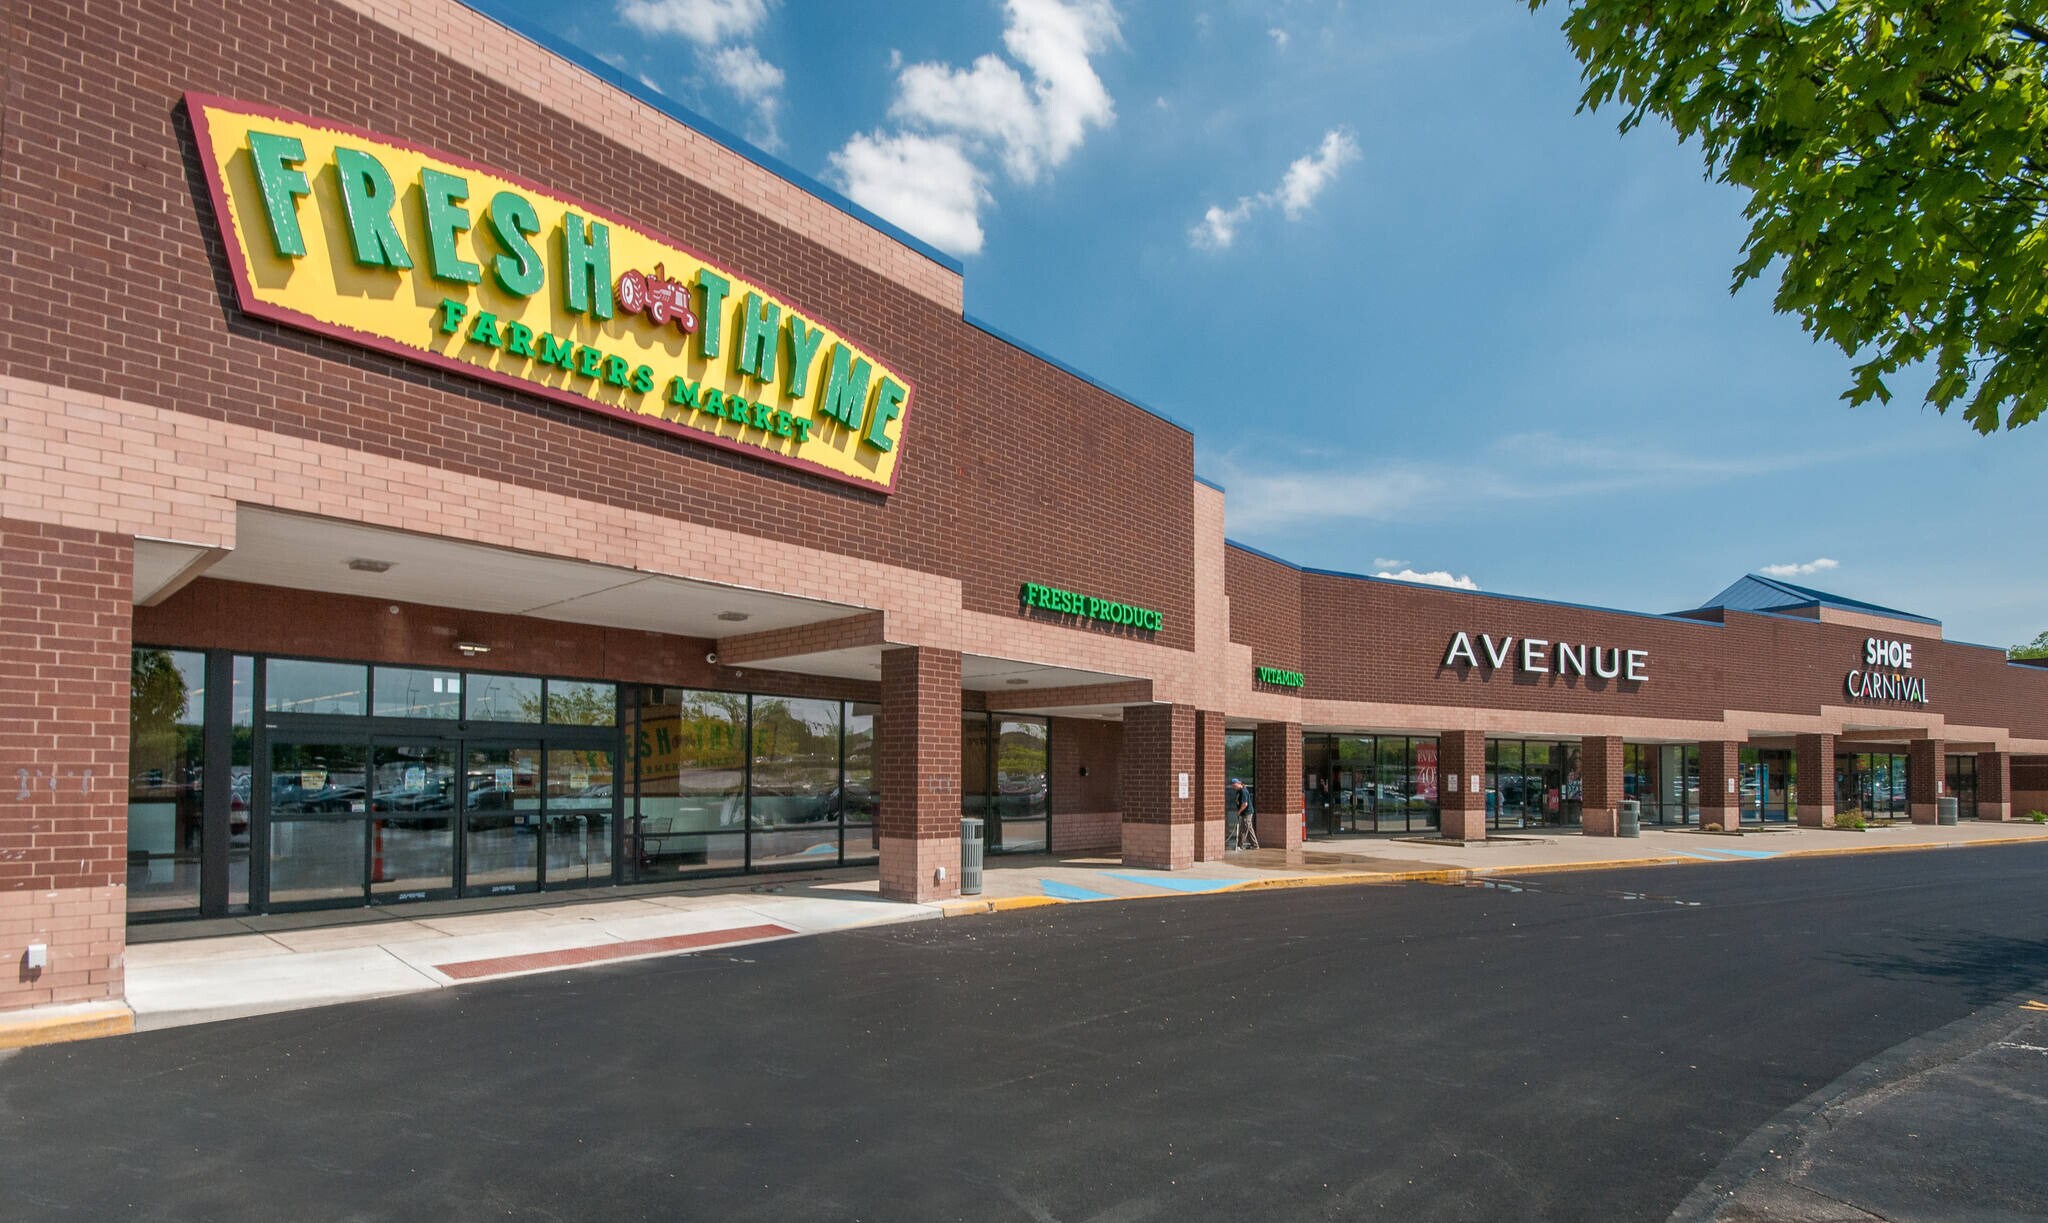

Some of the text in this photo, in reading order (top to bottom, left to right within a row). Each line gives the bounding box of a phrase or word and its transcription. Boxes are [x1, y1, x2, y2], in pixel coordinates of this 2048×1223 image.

[246, 129, 905, 453] FRESH THYME
[440, 299, 814, 443] FARMERS MARKET
[1023, 582, 1163, 631] FRESH PRODUCE
[1259, 667, 1304, 688] VITAMINS
[1445, 631, 1649, 681] AVENUE
[1865, 637, 1912, 669] SHOE
